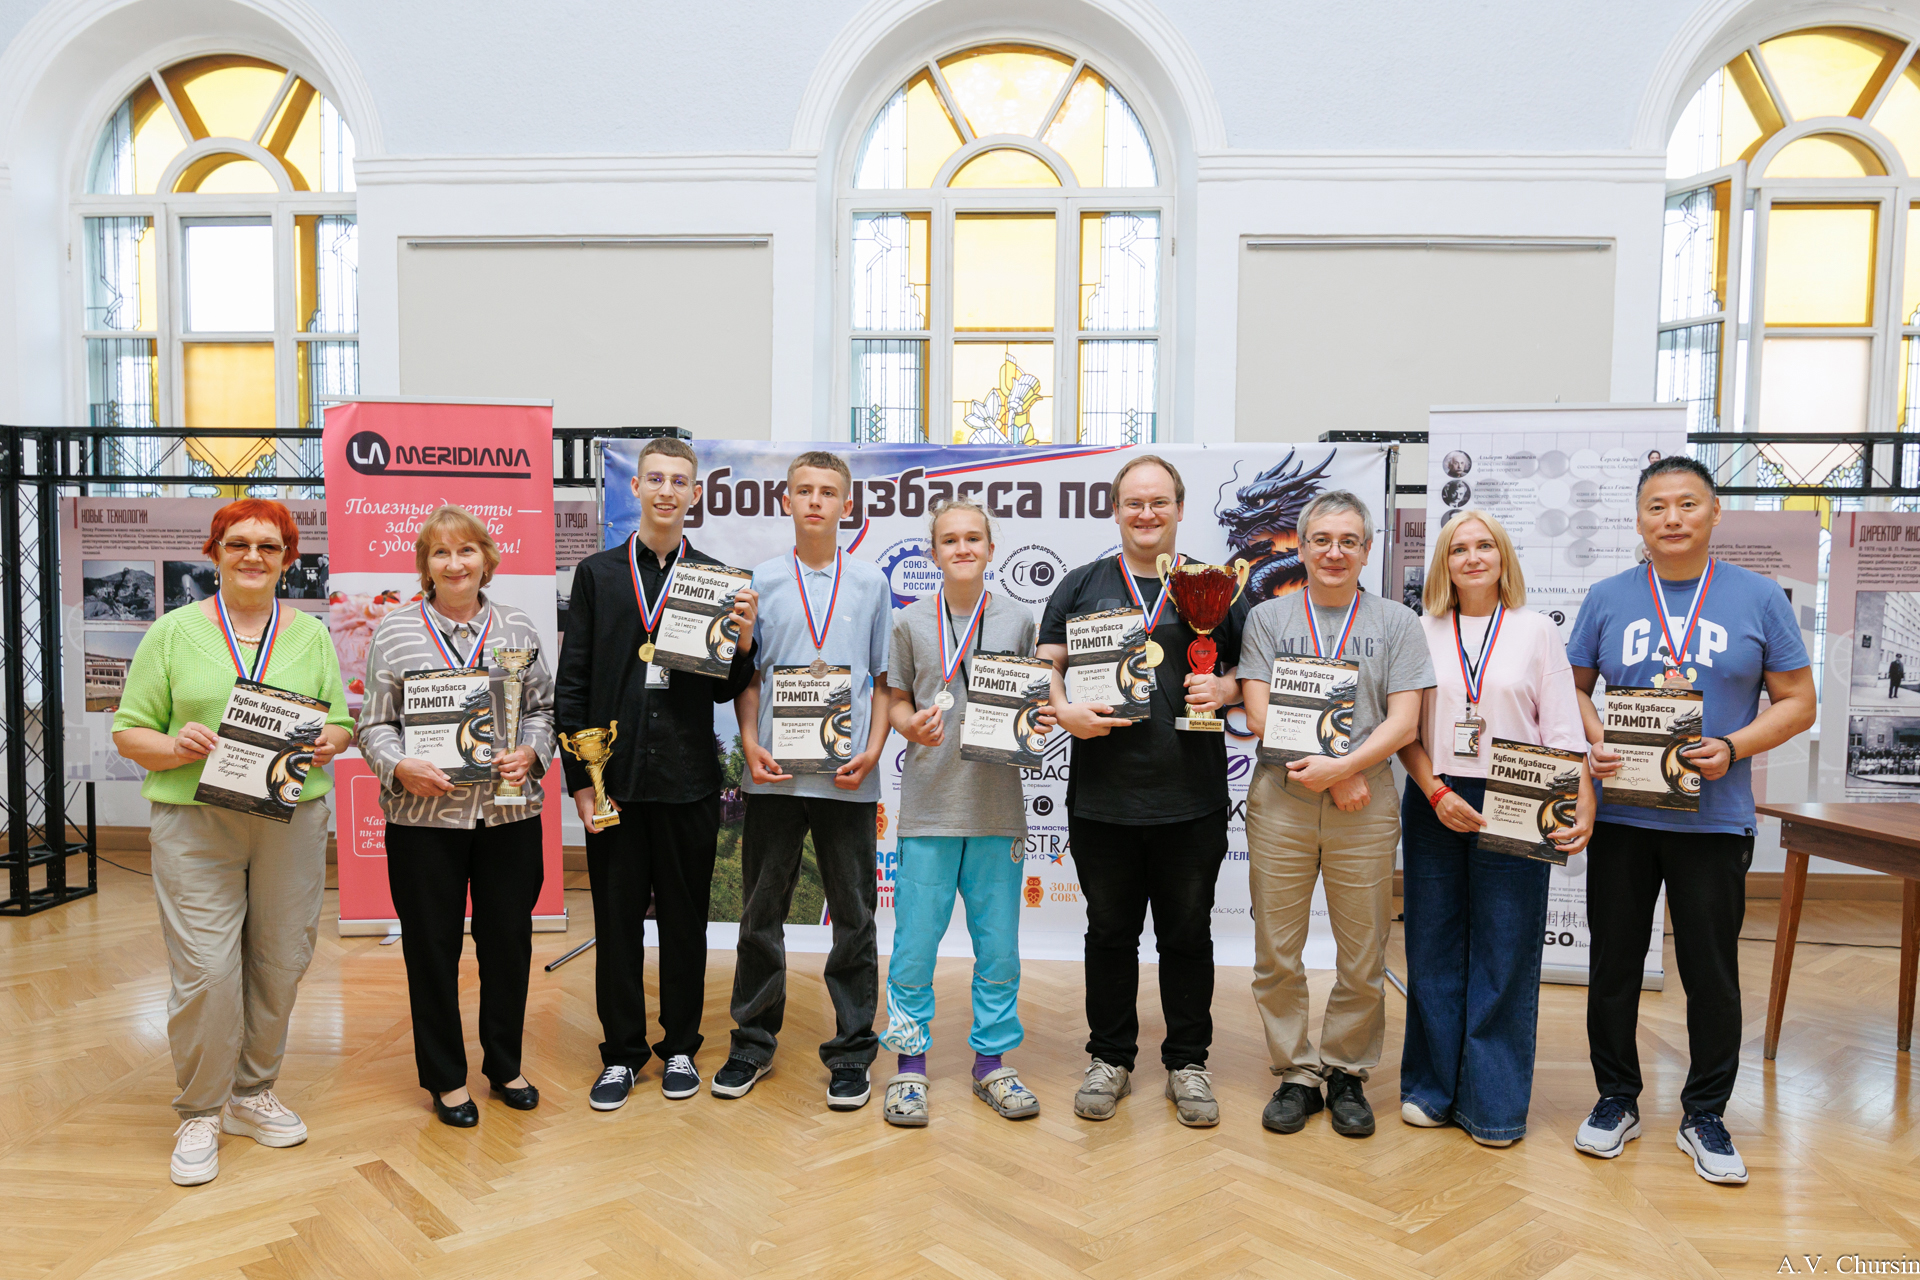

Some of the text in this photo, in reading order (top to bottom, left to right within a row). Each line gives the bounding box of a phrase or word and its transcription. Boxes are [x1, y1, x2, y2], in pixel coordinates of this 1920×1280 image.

[353, 442, 531, 467] LA MERIDIANA
[683, 467, 1114, 530] убок узбасса по
[345, 497, 513, 517] Полезные дсерты
[81, 509, 149, 524] НОВЫЕ ТЕХНОЛОГИИ
[564, 512, 588, 529] ТРУДА
[1859, 525, 1920, 542] ДИРЕКТОР ИНС
[369, 540, 377, 551] с
[903, 560, 928, 569] СОЮЗ
[998, 544, 1030, 573] Российская
[675, 571, 729, 588] Кубок Кузбасса
[903, 582, 936, 590] РОССИИ
[672, 583, 715, 601] ГРАМОТА
[1069, 623, 1124, 637] Кубок Кузбасса
[1070, 635, 1113, 651] ГРАМОТА
[1622, 616, 1728, 668] GAP
[973, 664, 1030, 679] Кубок Кузбасса
[1276, 666, 1335, 681] Кубок Кузбасса
[407, 683, 466, 696] Кубок Кузбасса
[776, 680, 830, 688] Кубок Кузбасса
[972, 675, 1017, 693] ГРАМОТА
[1274, 678, 1321, 694] ГРАМОТА
[408, 695, 455, 709] ГРАМОТА
[776, 691, 819, 702] ГРАМОТА
[233, 694, 300, 719] Кубок Кузбасса
[1608, 701, 1676, 714] Кубок Кузбасса
[227, 707, 282, 732] ГРАМОТА
[1608, 714, 1662, 729] ГРАМОТА
[1493, 752, 1557, 771] Кубок Кузбасса
[1491, 764, 1541, 784] ГРАМОТА
[363, 815, 387, 827] Час
[1049, 882, 1081, 893] ЗОЛО
[1050, 893, 1078, 902] СОВА
